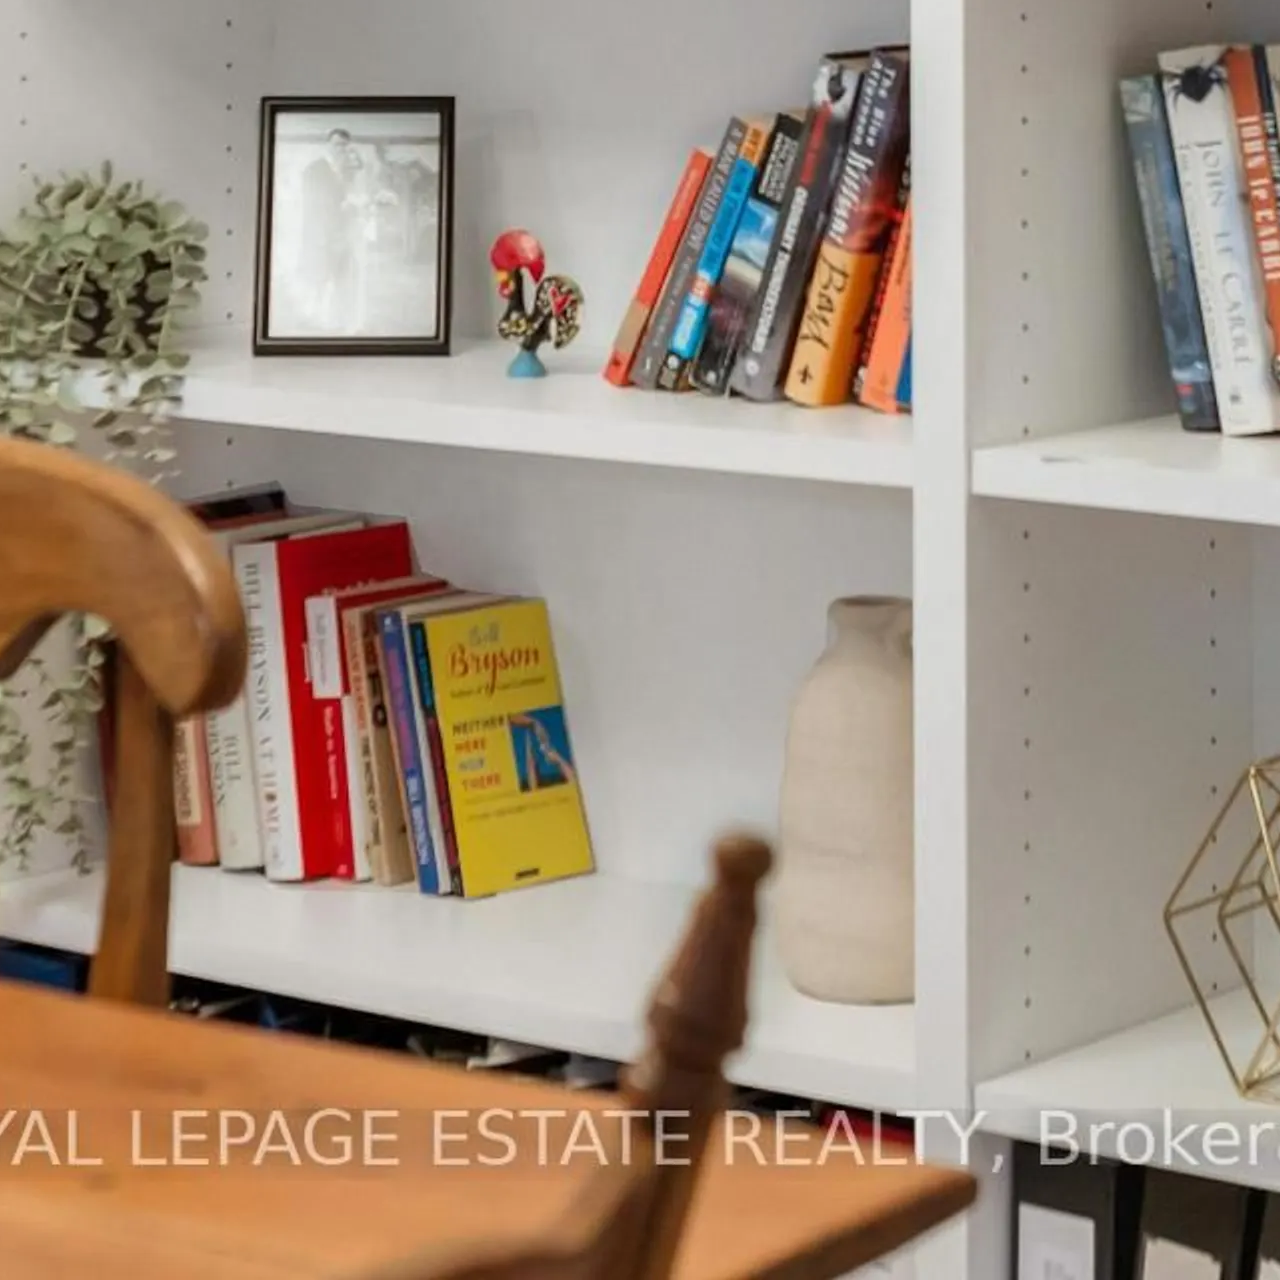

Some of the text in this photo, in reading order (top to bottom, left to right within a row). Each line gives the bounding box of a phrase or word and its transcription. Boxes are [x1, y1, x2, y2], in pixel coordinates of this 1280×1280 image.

[867, 66, 897, 148] The Blue
[1238, 114, 1267, 170] JOHN
[686, 139, 740, 255] MAN CALLED OVE
[1249, 178, 1269, 205] le
[752, 185, 809, 354] ORDINARY THUNDERSTORMS
[1194, 140, 1253, 371] JOHN LE CARRÉ
[243, 562, 275, 761] BILL BRYSON AT
[447, 641, 541, 696] Bryson
[452, 715, 507, 737] NEITHER
[455, 738, 487, 753] HERE
[224, 734, 242, 782] BILL
[461, 772, 502, 793] THERE
